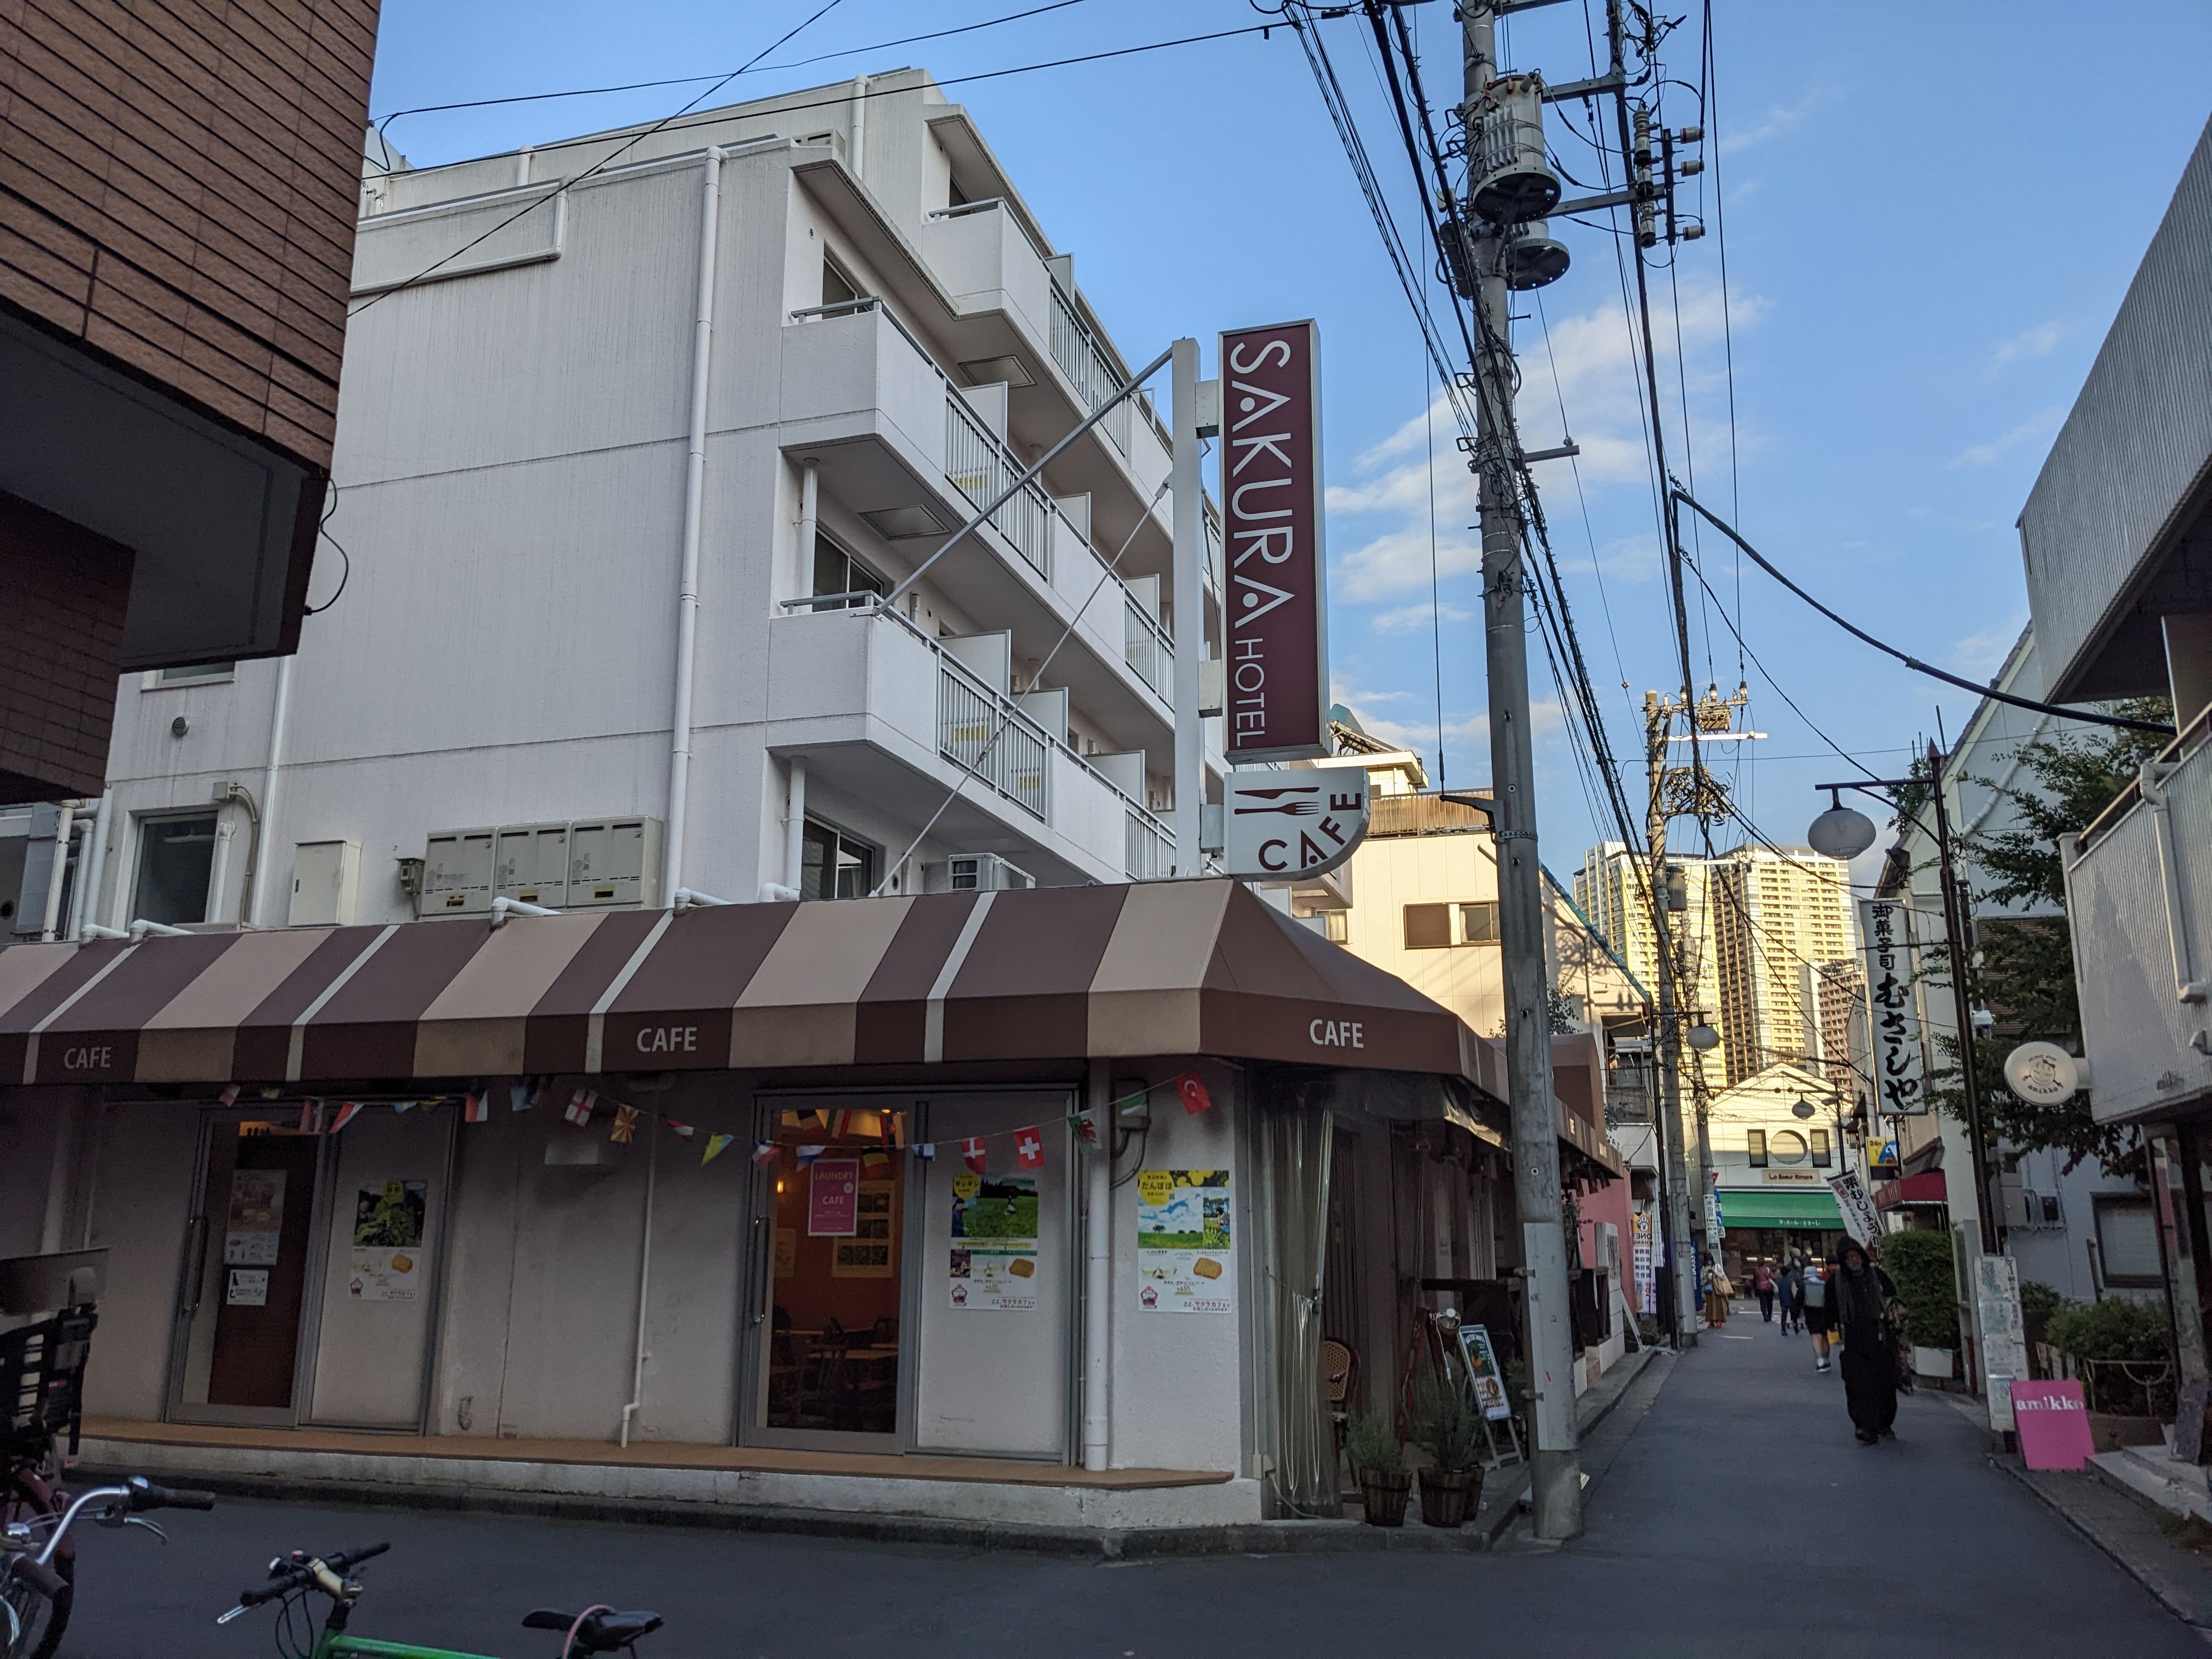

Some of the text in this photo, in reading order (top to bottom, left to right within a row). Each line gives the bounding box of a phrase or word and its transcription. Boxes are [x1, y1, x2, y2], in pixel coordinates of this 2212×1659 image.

[1230, 340, 1295, 747] SAKURA HOTEL
[1259, 792, 1362, 871] CAFE
[636, 1026, 697, 1053] CAFE
[1310, 1019, 1364, 1048] CAFE
[1874, 972, 1918, 1111] むさしや
[64, 1046, 111, 1069] CAFE
[815, 1171, 854, 1181] LAUNDRY
[2016, 1396, 2084, 1410] amikko
